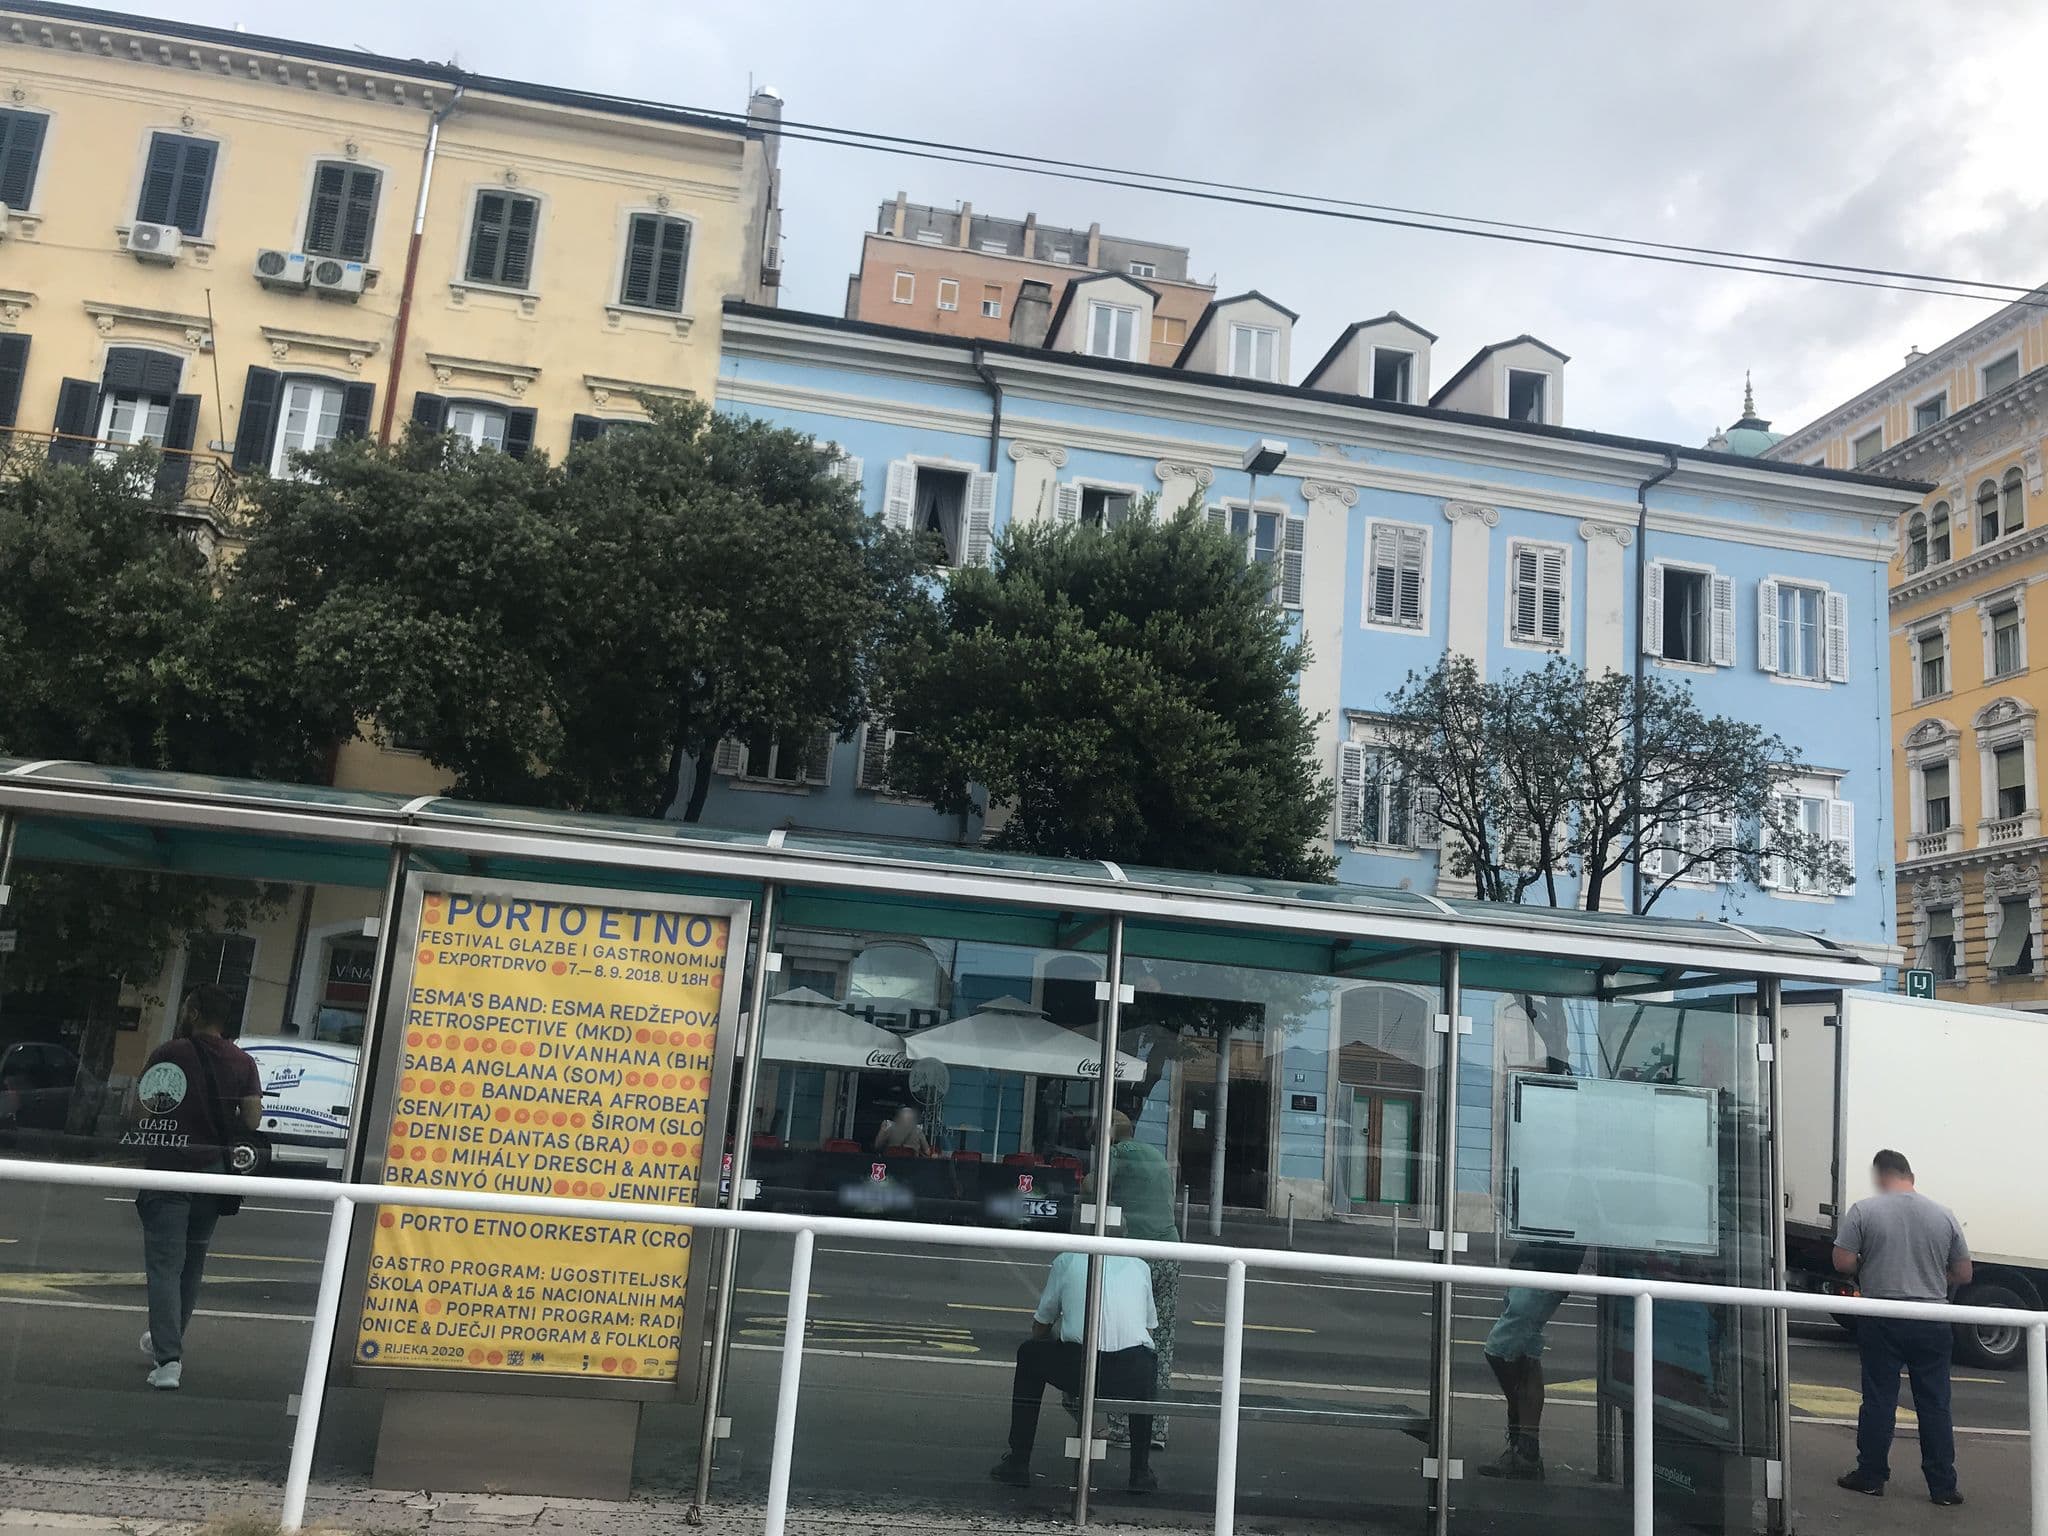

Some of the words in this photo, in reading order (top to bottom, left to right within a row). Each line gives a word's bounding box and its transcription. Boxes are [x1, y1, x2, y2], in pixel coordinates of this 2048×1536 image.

[447, 896, 587, 936] PORTO
[600, 909, 712, 947] ETNO
[421, 930, 503, 949] FESTIVAL
[510, 938, 577, 955] GLAZBE
[439, 952, 546, 972] EXPORTDRVO
[668, 971, 677, 983] U
[682, 973, 708, 986] 18H
[489, 994, 546, 1012] BAND:
[552, 1000, 605, 1018] ESMA
[409, 1009, 567, 1037] RETROSPECTIVE
[576, 1023, 632, 1043] (MKD)
[539, 1043, 660, 1066] DIVANHANA
[403, 1054, 455, 1073] SABA
[462, 1059, 557, 1080] ANGLANA
[564, 1066, 622, 1086] (SOM)
[482, 1083, 602, 1106] BANDANERA
[592, 1110, 655, 1133] ŠIROM
[410, 1122, 484, 1143] DENISE
[490, 1128, 569, 1149] DANTAS
[575, 1134, 629, 1154] (BRA)
[452, 1148, 533, 1170] MIHÁLY
[535, 1154, 616, 1175] DRESCH
[622, 1161, 633, 1176] &
[386, 1166, 487, 1188] BRASNYÓ
[495, 1173, 551, 1194] (HUN)
[401, 1213, 468, 1233] PORTO
[474, 1219, 526, 1237] ETNO
[530, 1223, 636, 1245] ORKESTAR
[372, 1254, 444, 1273] GASTRO
[451, 1261, 544, 1279] PROGRAM:
[369, 1273, 423, 1294] ŠKOLA
[428, 1280, 498, 1297] OPATIJA
[503, 1285, 512, 1298] &
[517, 1287, 535, 1299] 15
[542, 1287, 656, 1307] NACIONALNIH
[366, 1296, 419, 1313] NJINA
[446, 1302, 536, 1320] POPRATNI
[542, 1308, 634, 1326] PROGRAM:
[362, 1316, 417, 1334] ONICE
[421, 1321, 431, 1335] &
[436, 1321, 495, 1338] DJEČJI
[501, 1326, 586, 1343] PROGRAM
[591, 1331, 600, 1344] &
[385, 1343, 428, 1355] RIJEKA
[431, 1346, 464, 1357] 2020
